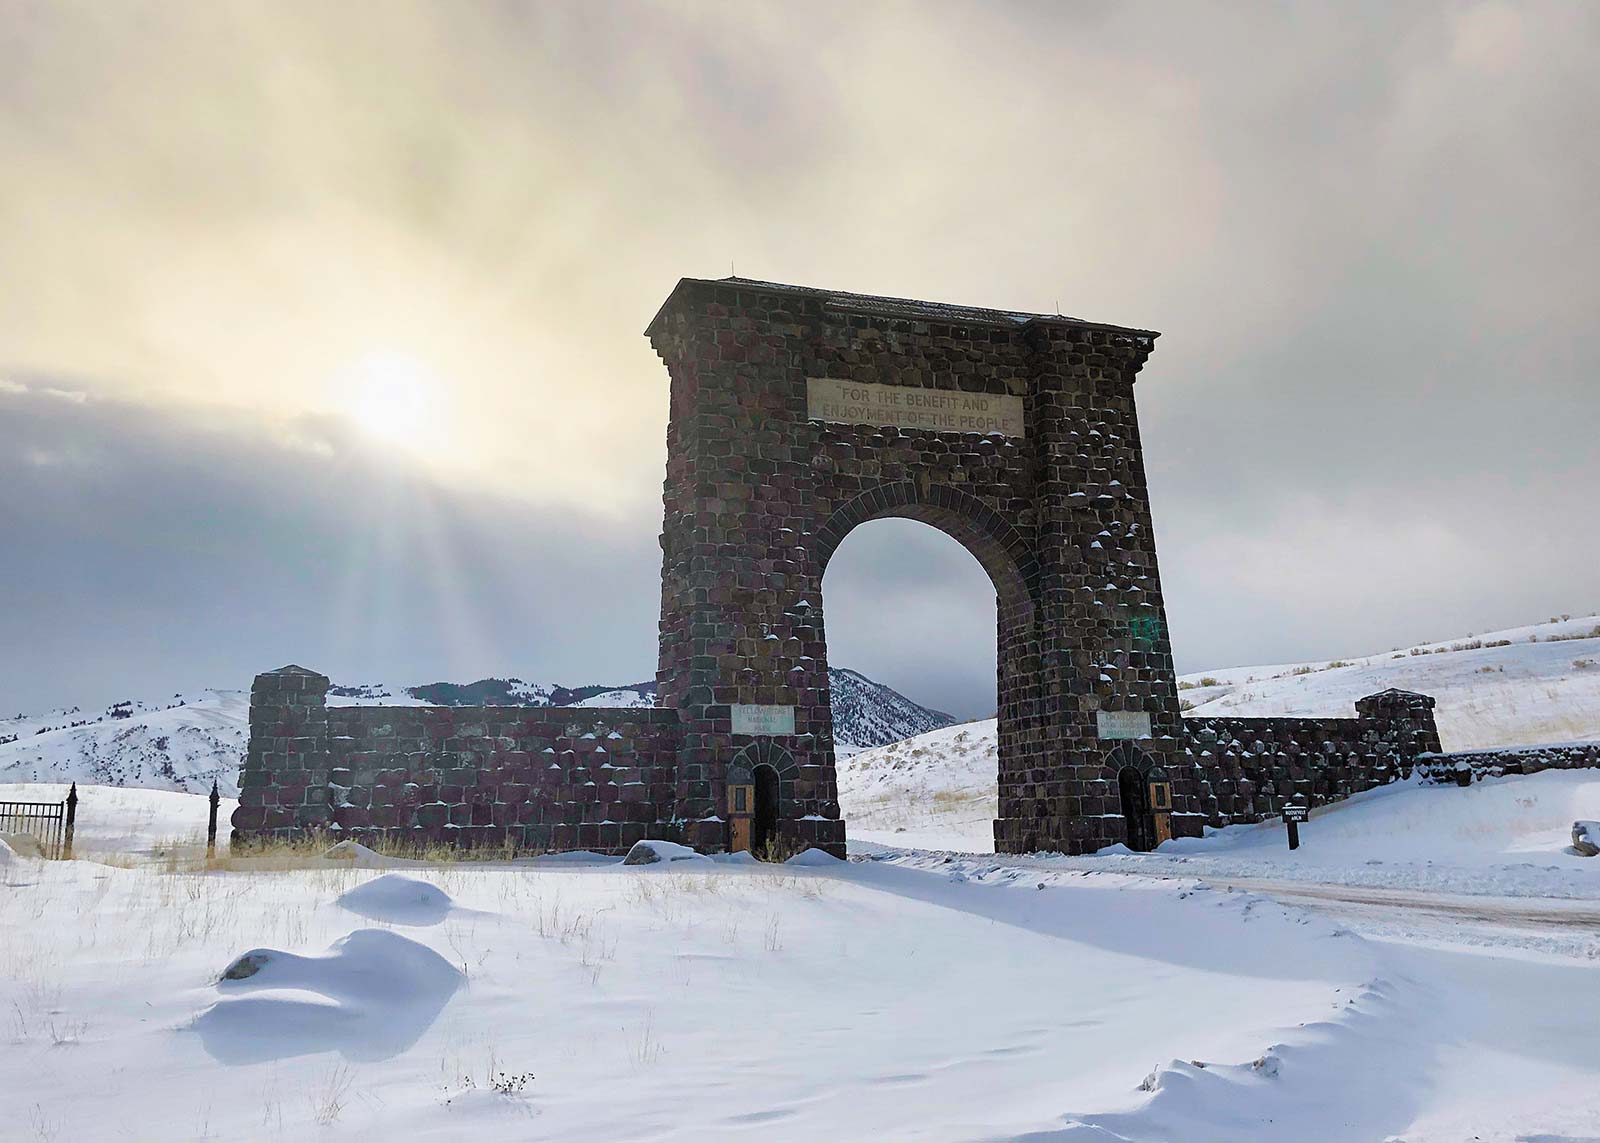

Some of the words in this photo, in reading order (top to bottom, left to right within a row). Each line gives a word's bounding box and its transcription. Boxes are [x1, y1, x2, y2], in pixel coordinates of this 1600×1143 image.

[876, 391, 900, 405] THE
[906, 393, 958, 409] BENEFIT
[963, 398, 989, 411] AND
[823, 403, 902, 422] ENJOYMENT
[908, 412, 927, 424] OF
[931, 413, 955, 426] THE
